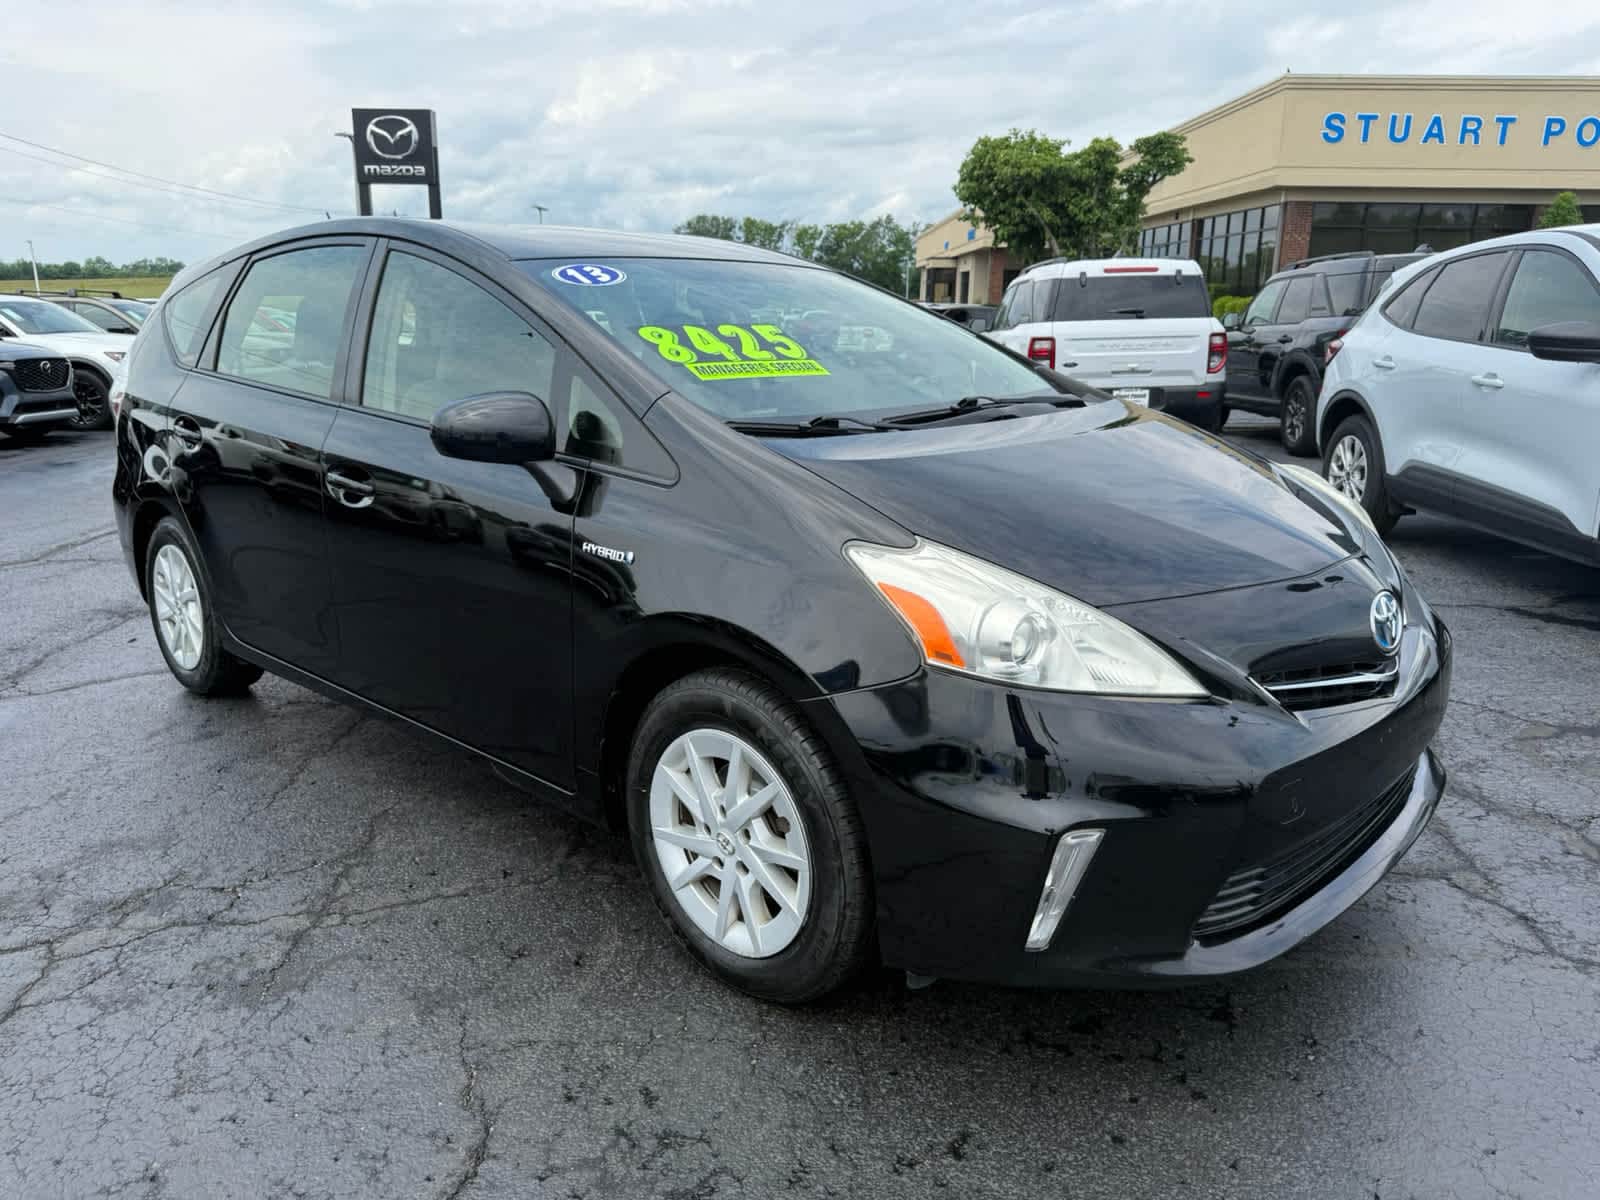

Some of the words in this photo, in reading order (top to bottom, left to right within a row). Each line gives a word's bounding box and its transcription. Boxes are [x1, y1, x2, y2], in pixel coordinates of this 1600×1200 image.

[1320, 112, 1517, 146] STUART
[1541, 115, 1600, 147] PO
[566, 266, 610, 284] 13
[638, 324, 807, 363] 8425
[582, 541, 624, 562] HYBRID
